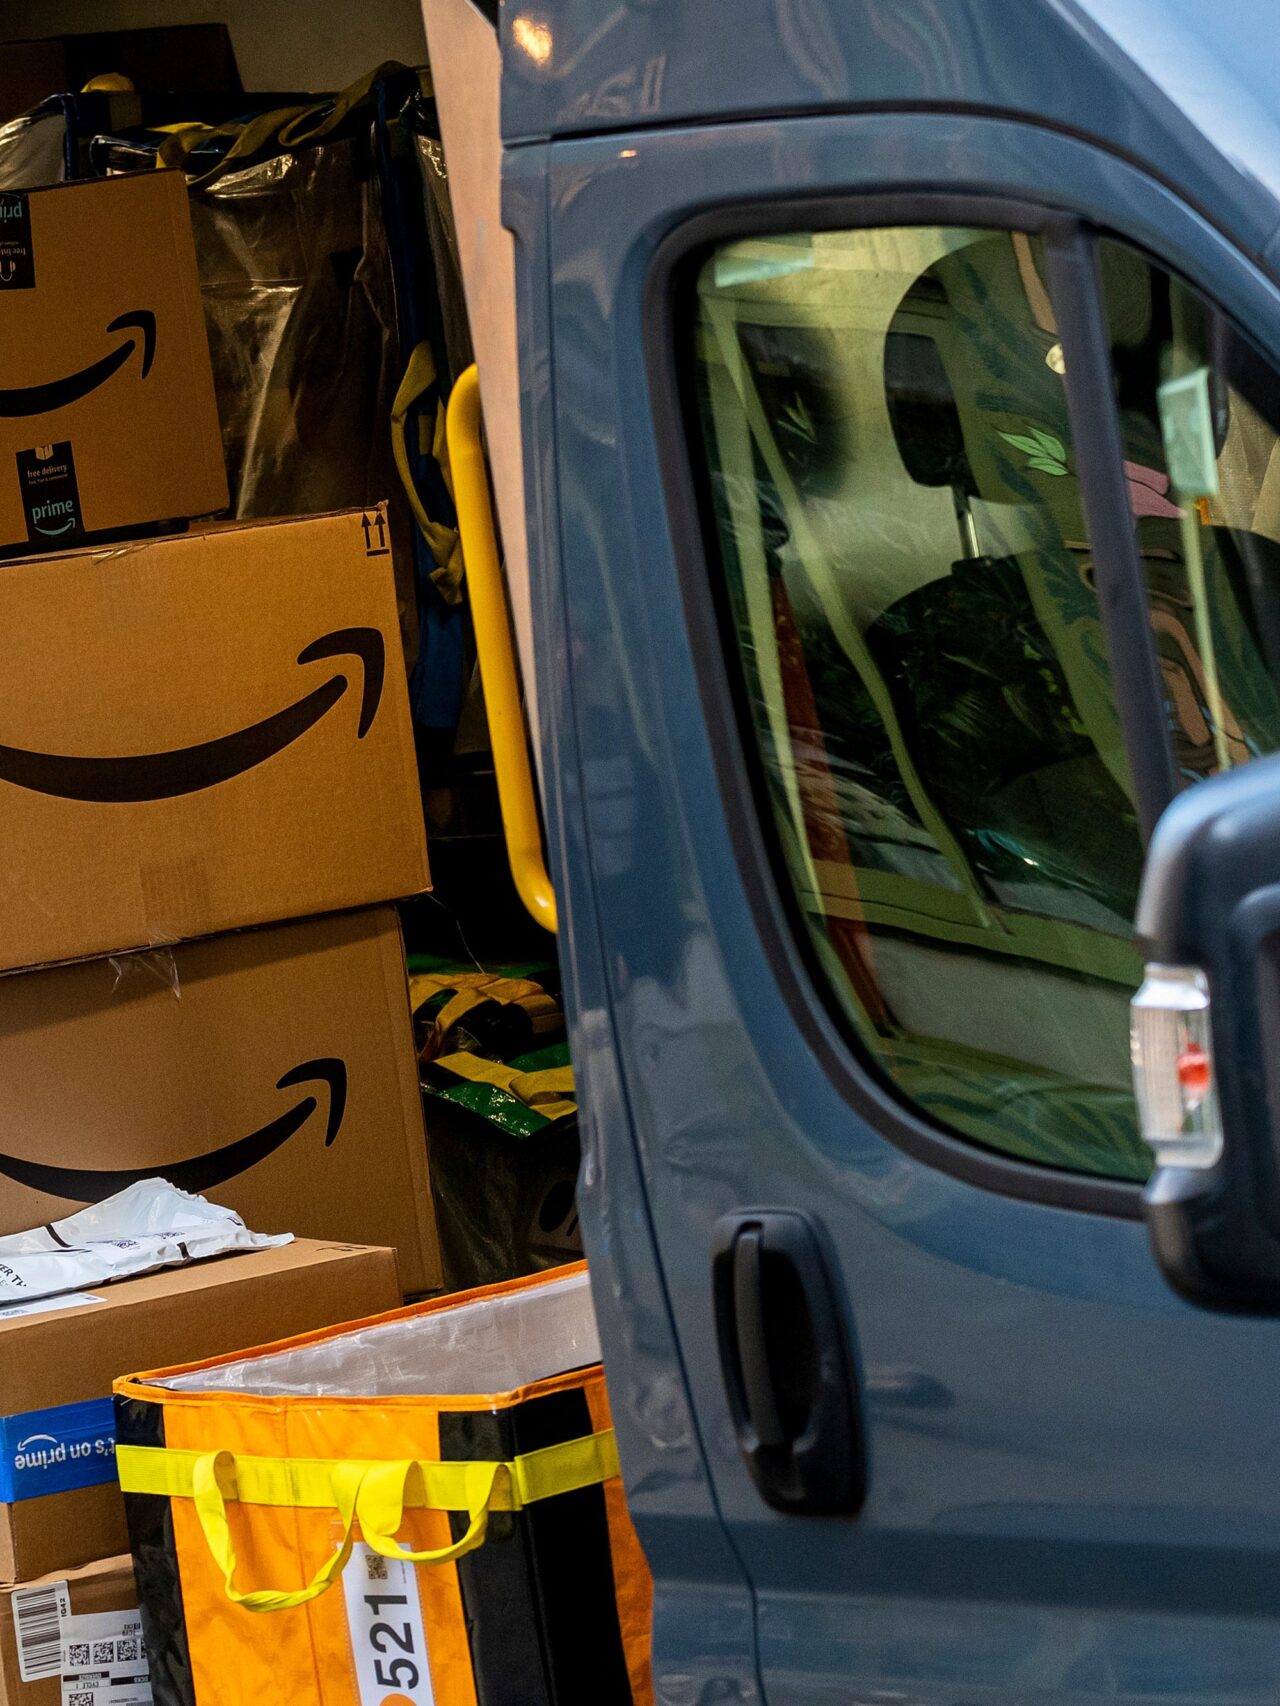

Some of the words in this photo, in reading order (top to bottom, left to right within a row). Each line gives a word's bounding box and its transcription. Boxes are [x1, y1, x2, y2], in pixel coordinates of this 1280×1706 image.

[12, 247, 26, 256] free
[27, 468, 41, 479] free
[41, 463, 68, 476] delivery
[31, 499, 74, 524] prime
[14, 1442, 67, 1470] prime
[70, 1442, 91, 1459] on
[363, 1594, 420, 1690] 521
